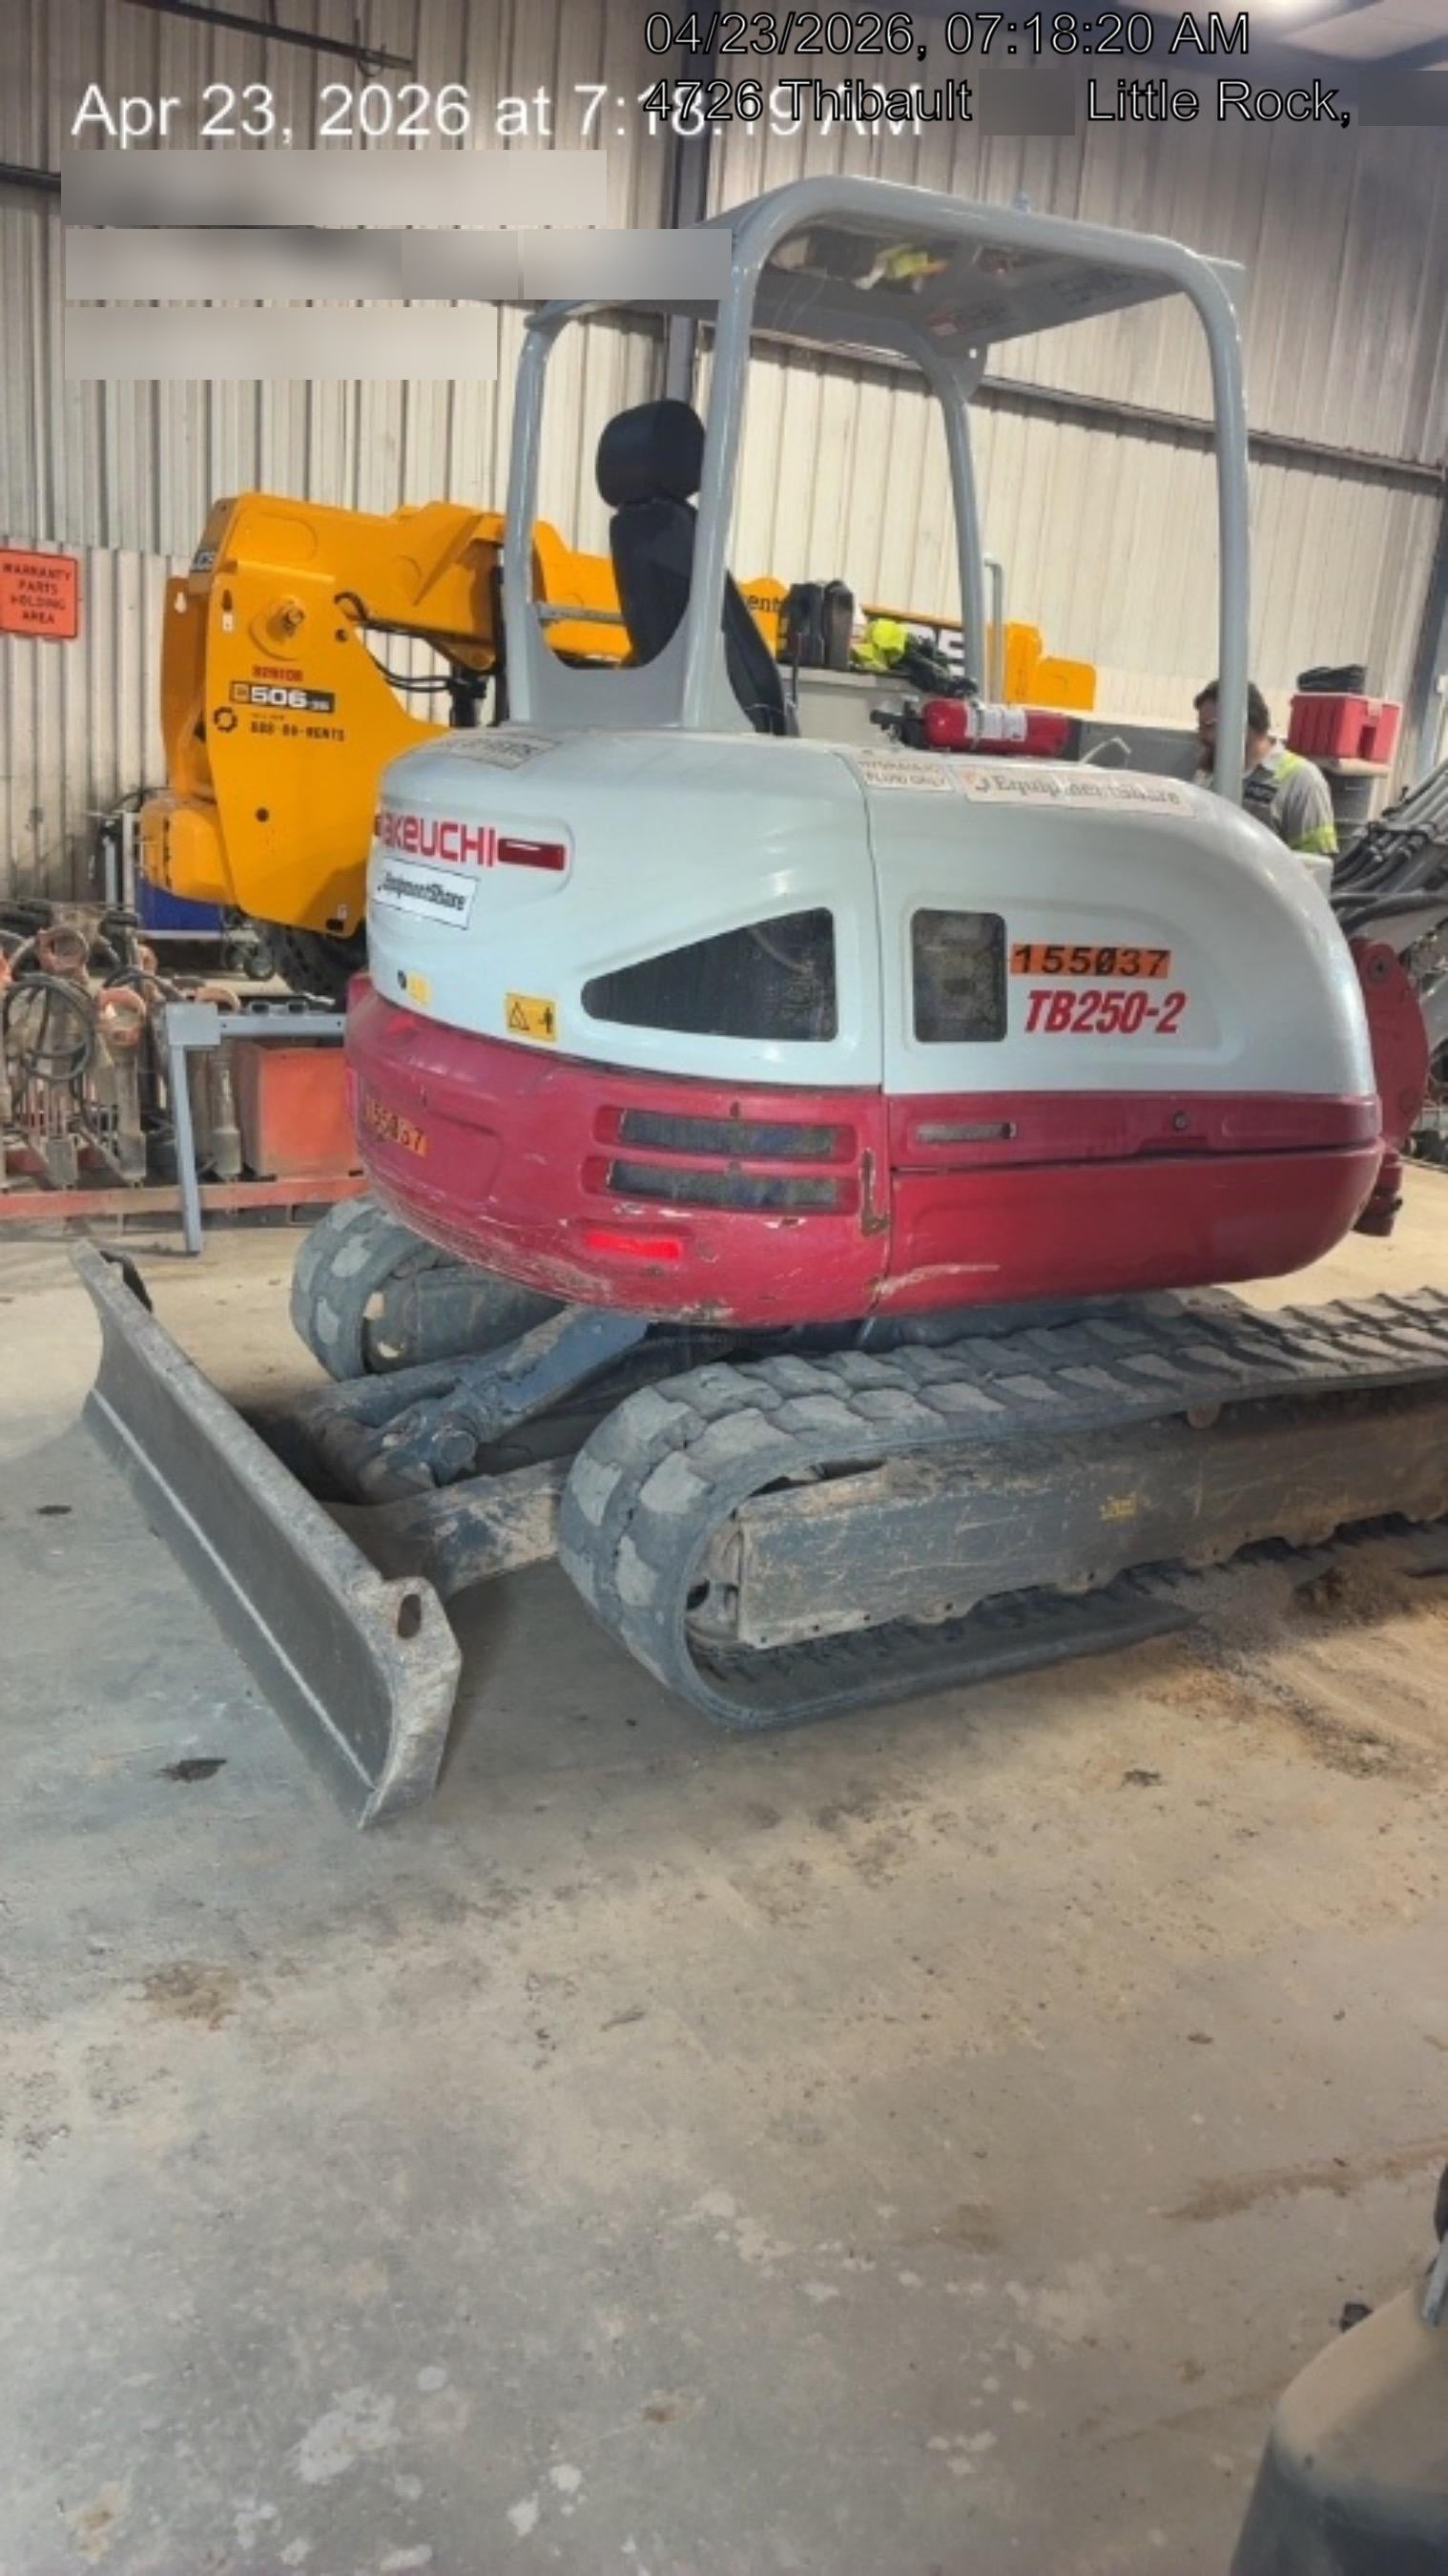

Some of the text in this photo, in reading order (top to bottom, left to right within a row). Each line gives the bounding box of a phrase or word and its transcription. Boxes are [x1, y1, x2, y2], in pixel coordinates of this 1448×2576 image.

[2, 564, 70, 581] WARRANTY
[18, 579, 58, 595] PARTS
[10, 594, 66, 611] HOLDING
[22, 611, 55, 625] AREA
[1015, 945, 1170, 977] 155037
[1024, 989, 1187, 1034] TB250-2
